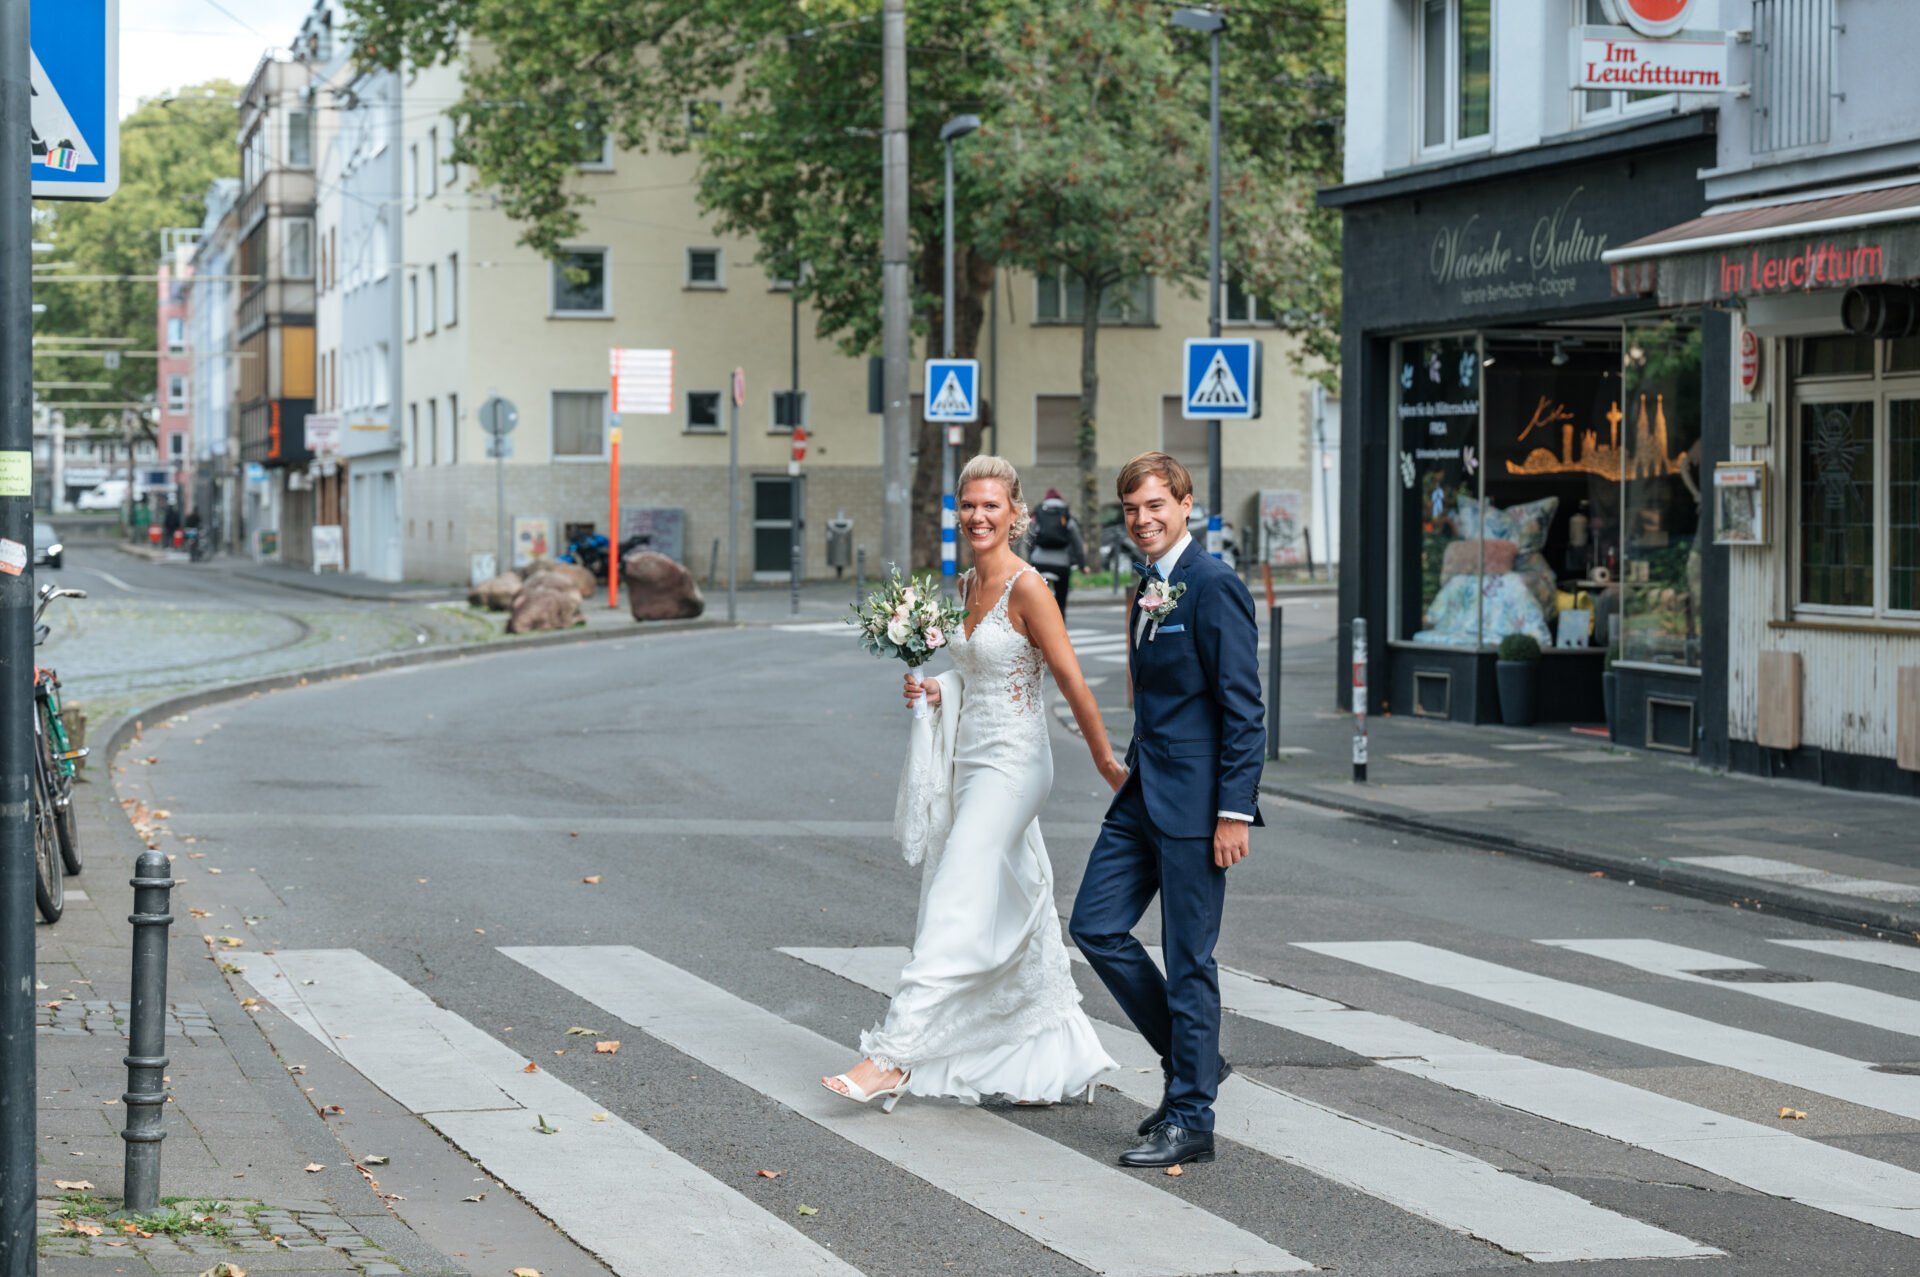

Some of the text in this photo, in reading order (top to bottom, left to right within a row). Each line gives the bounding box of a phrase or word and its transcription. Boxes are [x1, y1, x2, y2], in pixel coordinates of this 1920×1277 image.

[1603, 41, 1638, 63] Im
[1585, 61, 1722, 86] Leuchtturm
[1430, 213, 1512, 285] Waesche
[1529, 184, 1608, 280] Kultur
[1720, 241, 1884, 293] Im Leuchtturm
[1538, 277, 1577, 298] Cologne
